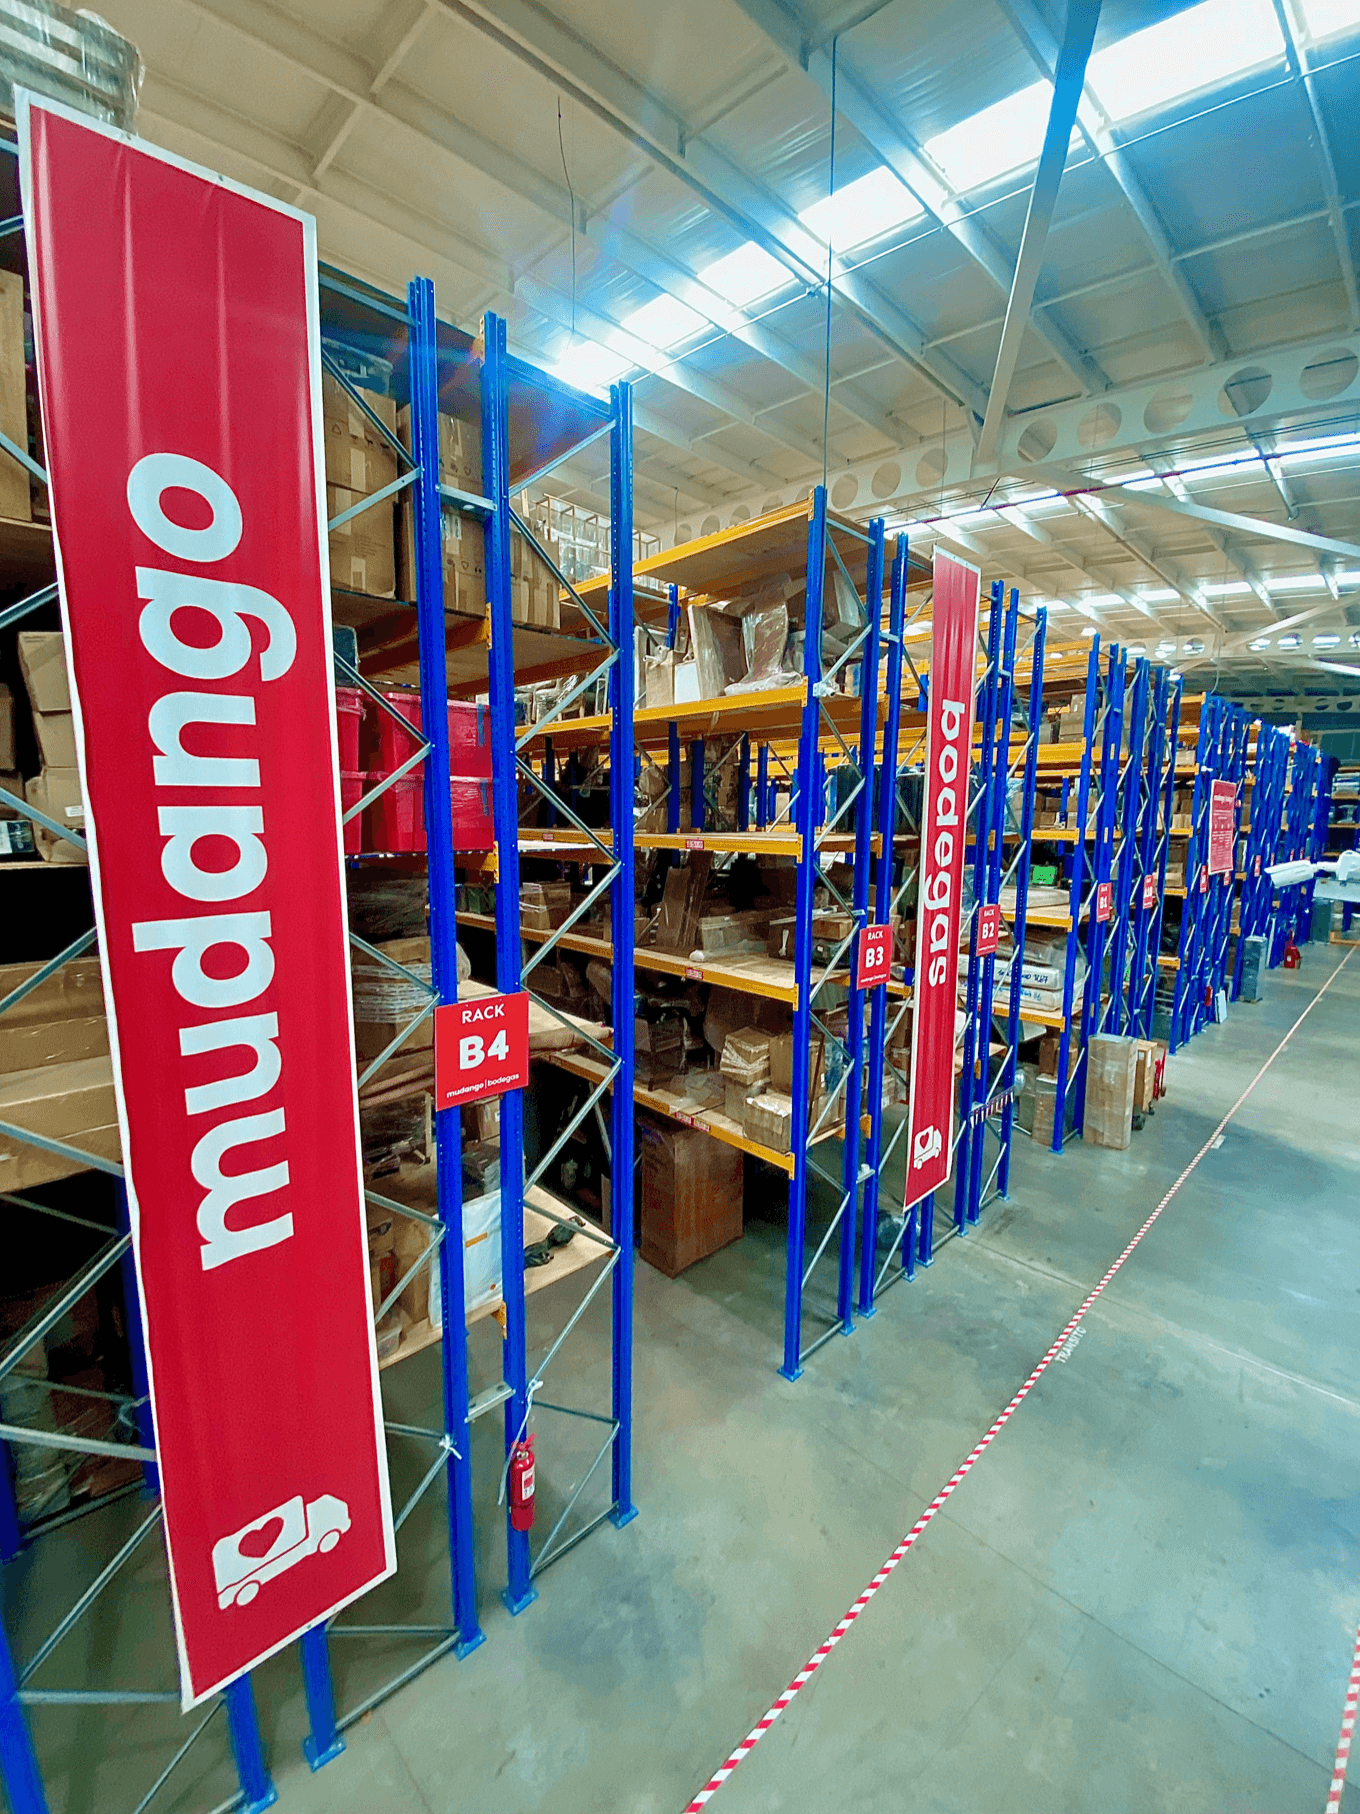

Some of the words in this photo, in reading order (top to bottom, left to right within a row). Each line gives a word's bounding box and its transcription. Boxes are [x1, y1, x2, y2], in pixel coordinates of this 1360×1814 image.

[922, 699, 965, 988] bodegas
[126, 452, 297, 1271] mudango
[867, 930, 883, 941] RACK
[982, 922, 995, 939] B2
[865, 946, 884, 968] B3
[462, 1003, 505, 1025] RACK
[459, 1029, 510, 1071] B4
